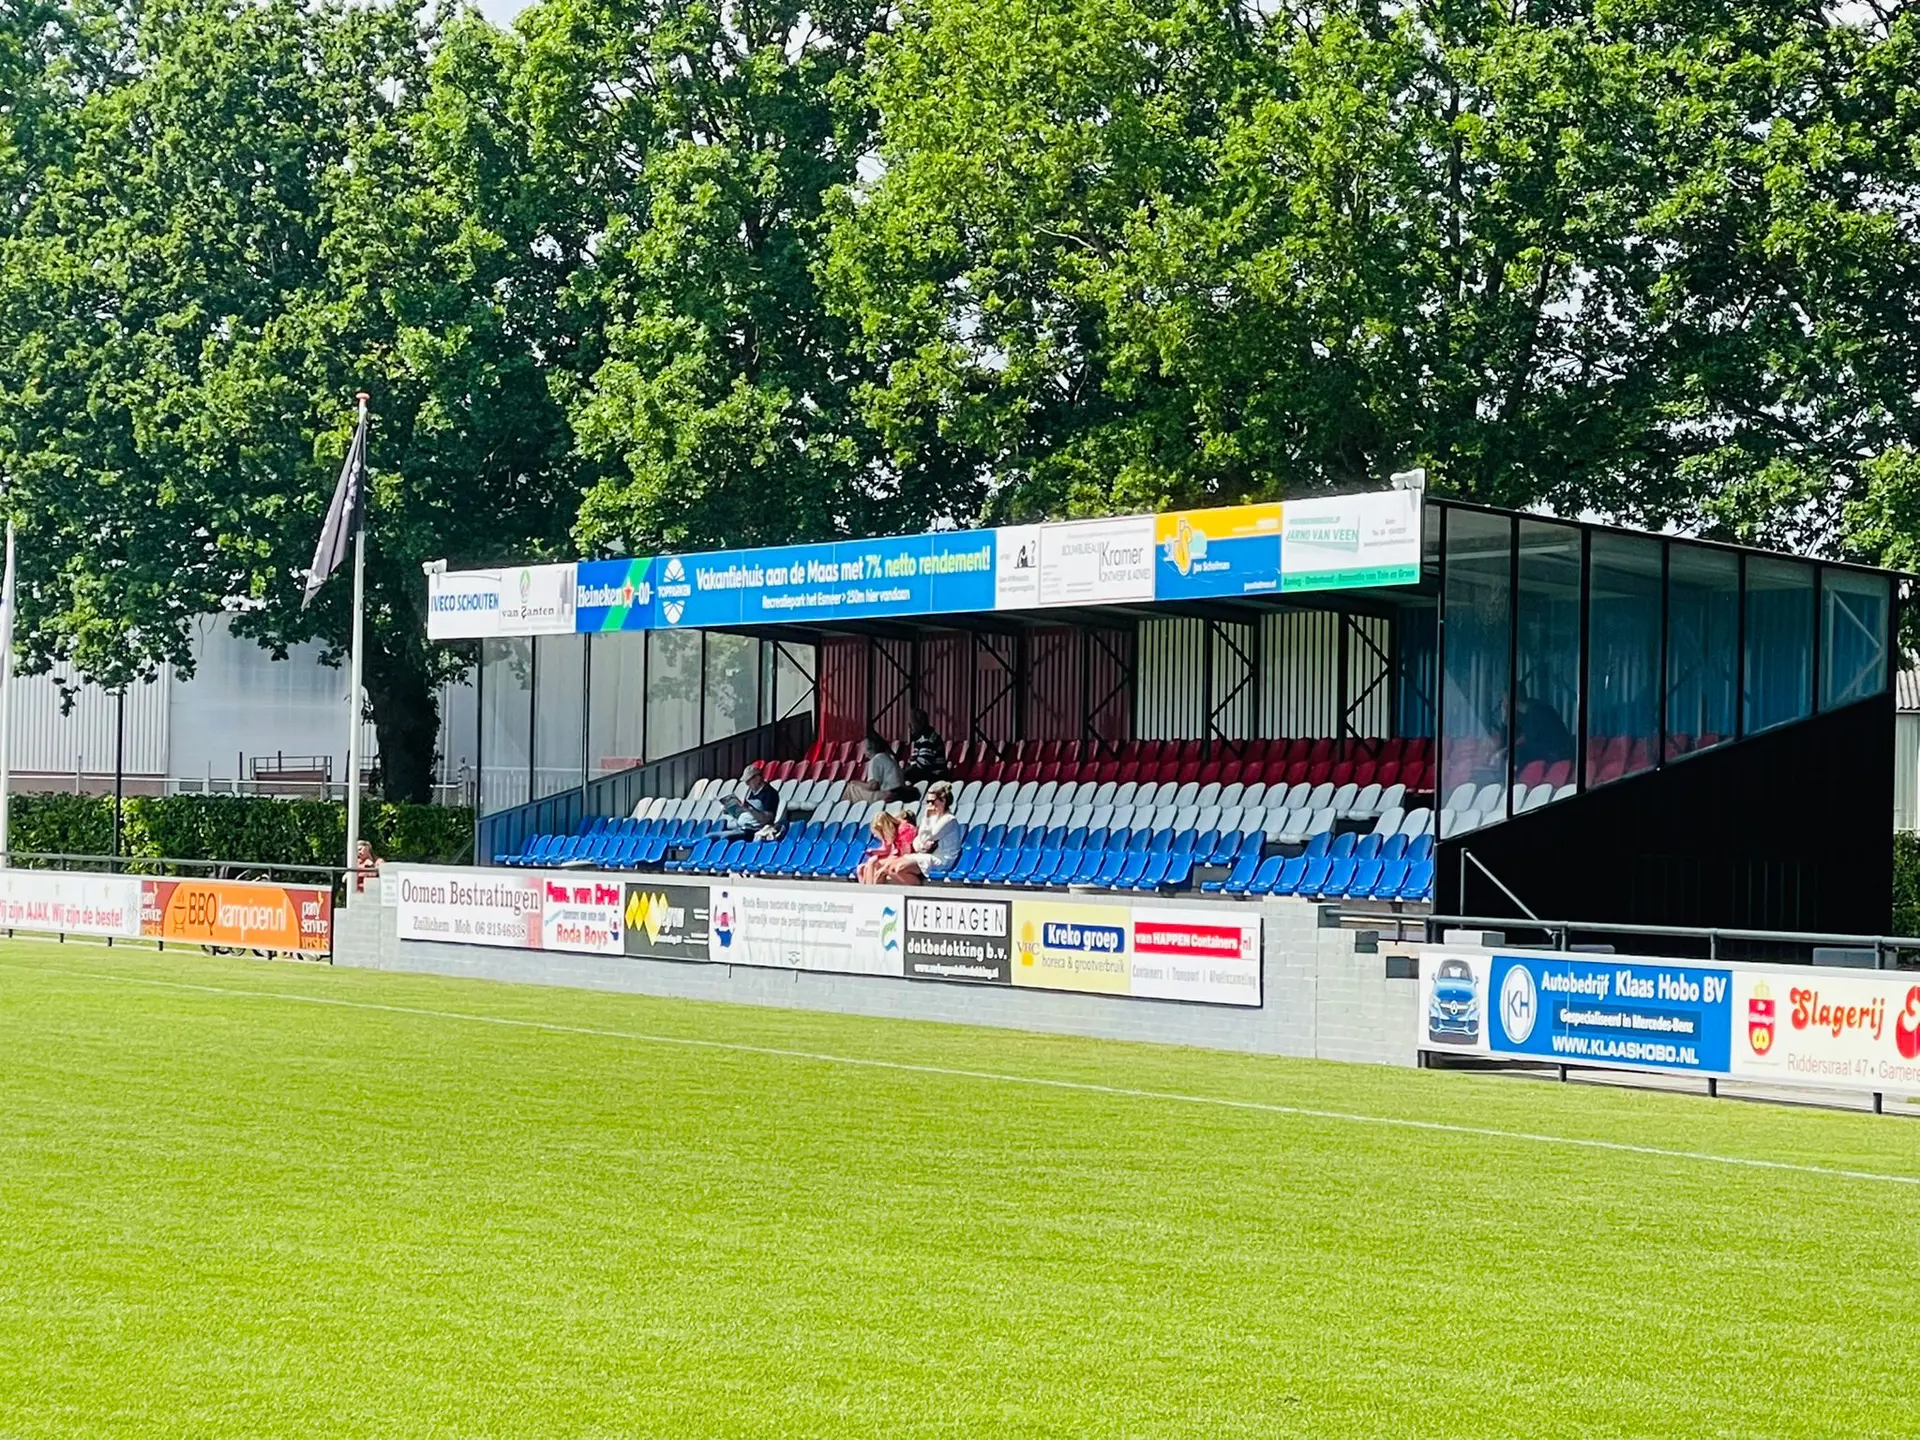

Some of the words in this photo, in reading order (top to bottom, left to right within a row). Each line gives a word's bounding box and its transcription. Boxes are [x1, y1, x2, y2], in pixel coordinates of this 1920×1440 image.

[1313, 530, 1331, 541] VAN
[1333, 529, 1359, 541] VEEN
[1101, 541, 1144, 567] Kramer
[696, 564, 764, 591] Vakantiehuis
[766, 567, 788, 586] aan
[790, 560, 805, 584] de
[808, 559, 839, 583] Maas
[841, 556, 864, 581] met
[865, 554, 882, 579] 7%
[885, 552, 916, 577] netto
[919, 545, 991, 575] rendement!
[431, 594, 455, 612] IVECO
[457, 593, 499, 610] SCHOUTEN
[577, 584, 623, 608] Heineken
[502, 610, 518, 618] van
[402, 878, 446, 904] Oomen
[450, 881, 539, 916] Bestratingen
[9, 901, 23, 924] zijn
[52, 904, 64, 928] Wij
[66, 905, 80, 928] zijn
[82, 905, 93, 924] de
[96, 906, 123, 928] beste!
[301, 916, 328, 934] service
[911, 906, 1004, 932] VERHAGEN
[475, 922, 486, 935] 06
[556, 923, 581, 944] Roda
[584, 926, 608, 950] Boys
[1048, 924, 1081, 946] Kreko
[1083, 931, 1118, 953] groep
[907, 938, 984, 962] dakbedekking
[986, 942, 1008, 960] b.v.
[1042, 955, 1066, 969] horeca
[1068, 956, 1073, 969] &
[1074, 958, 1124, 974] grootverbruik
[1541, 971, 1610, 1001] Autobedrijf
[1615, 970, 1654, 1000] Klaas
[1658, 974, 1700, 1002] Hobo
[1704, 976, 1727, 1004] BV
[1507, 988, 1531, 1019] KH
[1790, 986, 1886, 1041] Slagerij
[1560, 1008, 1621, 1029] Gespecialiseerd
[1622, 1012, 1632, 1028] in
[1632, 1013, 1694, 1034] Mercedes-Benz
[1552, 1036, 1700, 1065] WWW.KLAASHOBO.NL
[1788, 1053, 1852, 1076] Ridderstraat
[1854, 1060, 1868, 1077] 47
